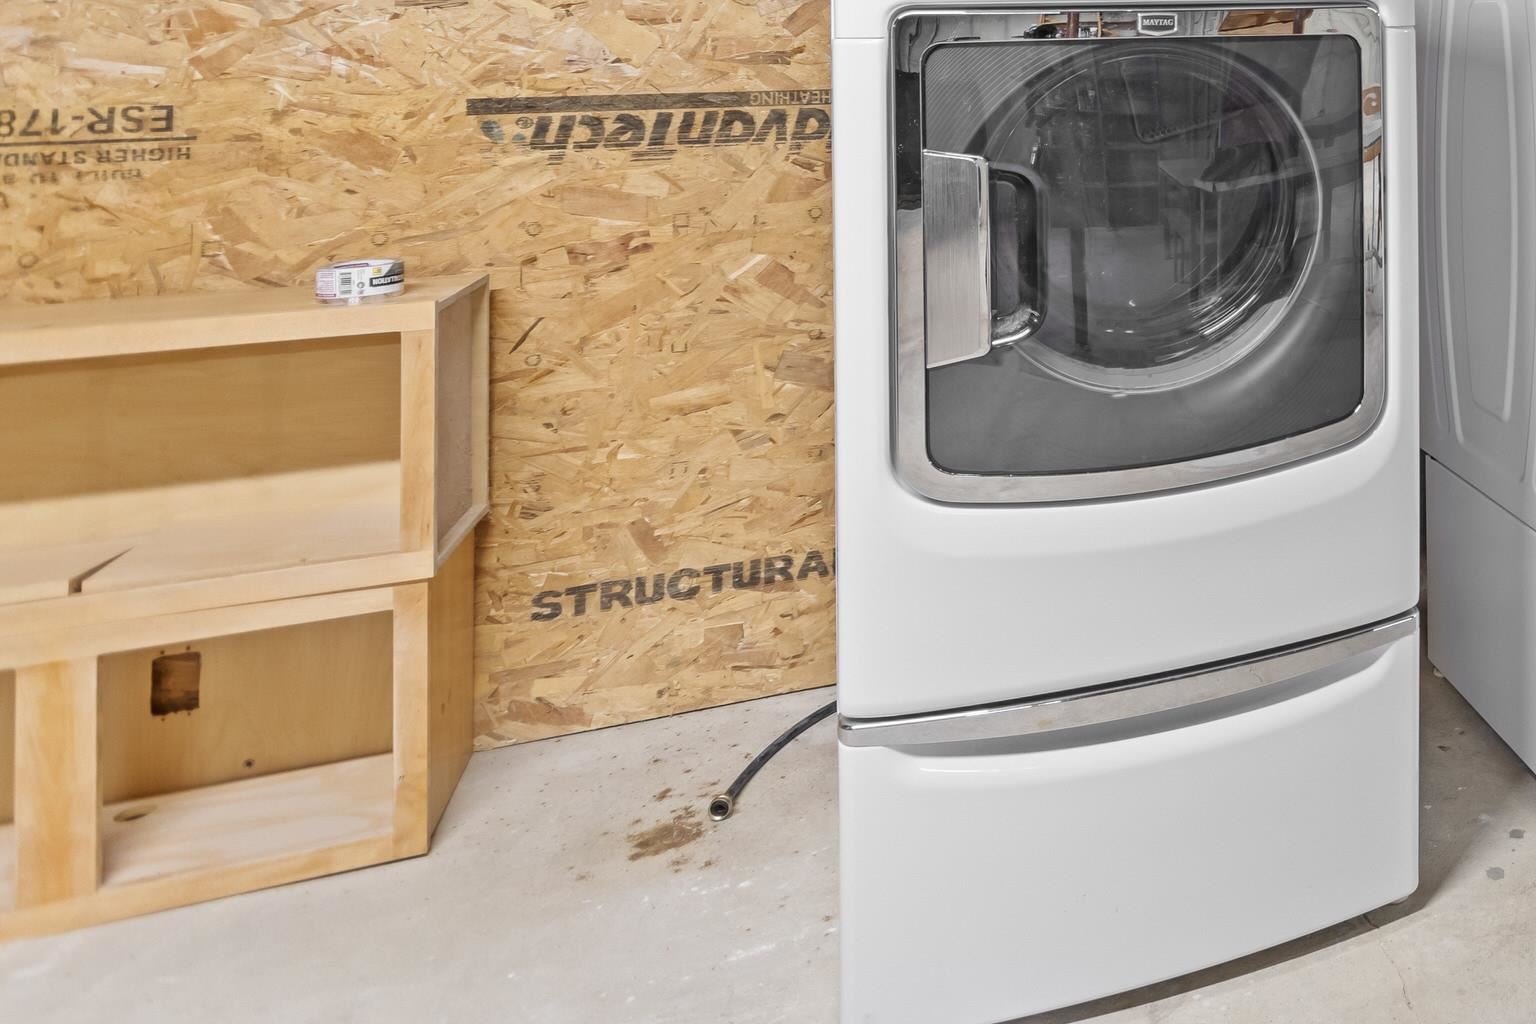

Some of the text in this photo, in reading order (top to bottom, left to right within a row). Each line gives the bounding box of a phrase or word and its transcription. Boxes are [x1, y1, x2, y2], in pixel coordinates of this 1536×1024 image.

[1142, 18, 1174, 26] MAYTAG
[529, 108, 832, 165] dvanTech
[0, 146, 191, 167] HIGHER STAND
[530, 549, 835, 622] STRUCTURA
